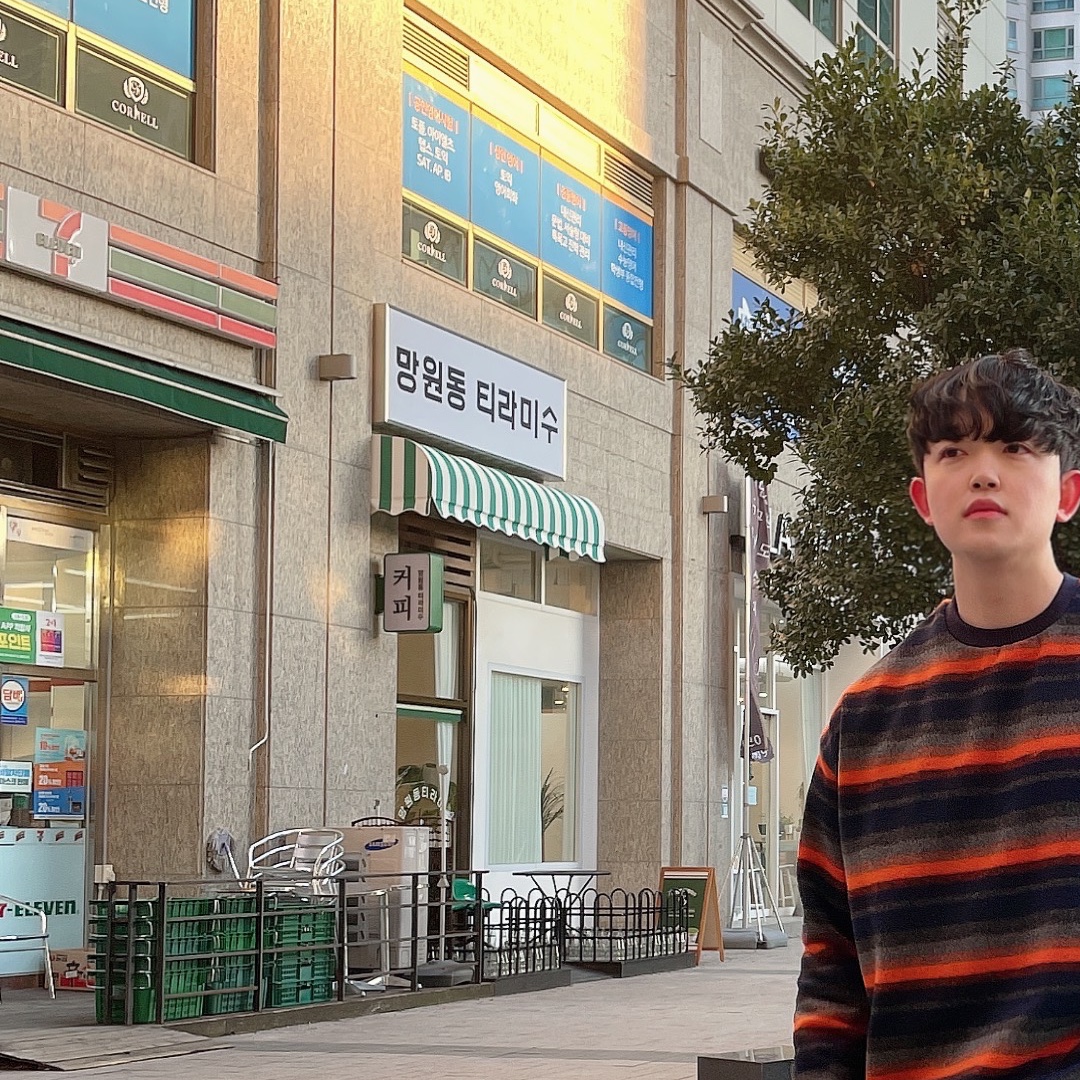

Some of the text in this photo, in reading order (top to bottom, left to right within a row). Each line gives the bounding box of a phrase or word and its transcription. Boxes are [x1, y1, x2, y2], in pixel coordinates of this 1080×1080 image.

[111, 99, 159, 130] CORNELL
[396, 346, 558, 444] 망원동 티라미수
[393, 565, 411, 621] 커피
